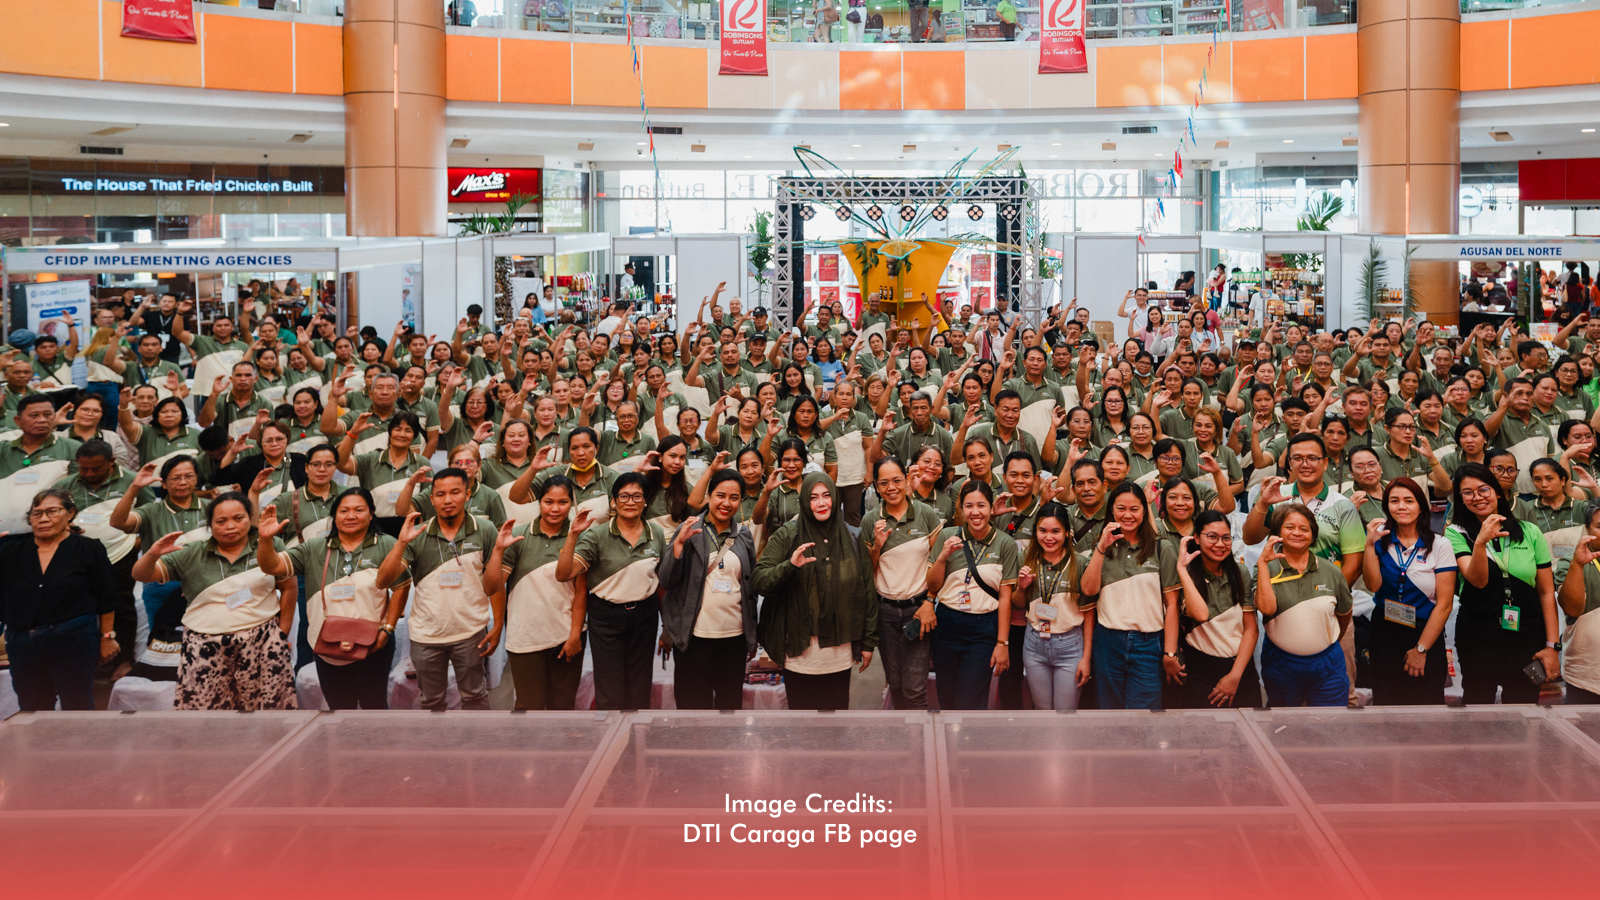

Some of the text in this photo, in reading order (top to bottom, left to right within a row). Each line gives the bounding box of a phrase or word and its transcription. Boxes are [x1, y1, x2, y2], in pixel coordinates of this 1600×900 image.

[62, 178, 313, 192] The House That Fried Chicken Built
[451, 172, 505, 196] Max's
[1460, 247, 1562, 256] AGUSAN DEL NORTE
[44, 255, 292, 266] CFIDP IMPLEMENTING AGENCIES
[151, 642, 182, 652] CFIDP
